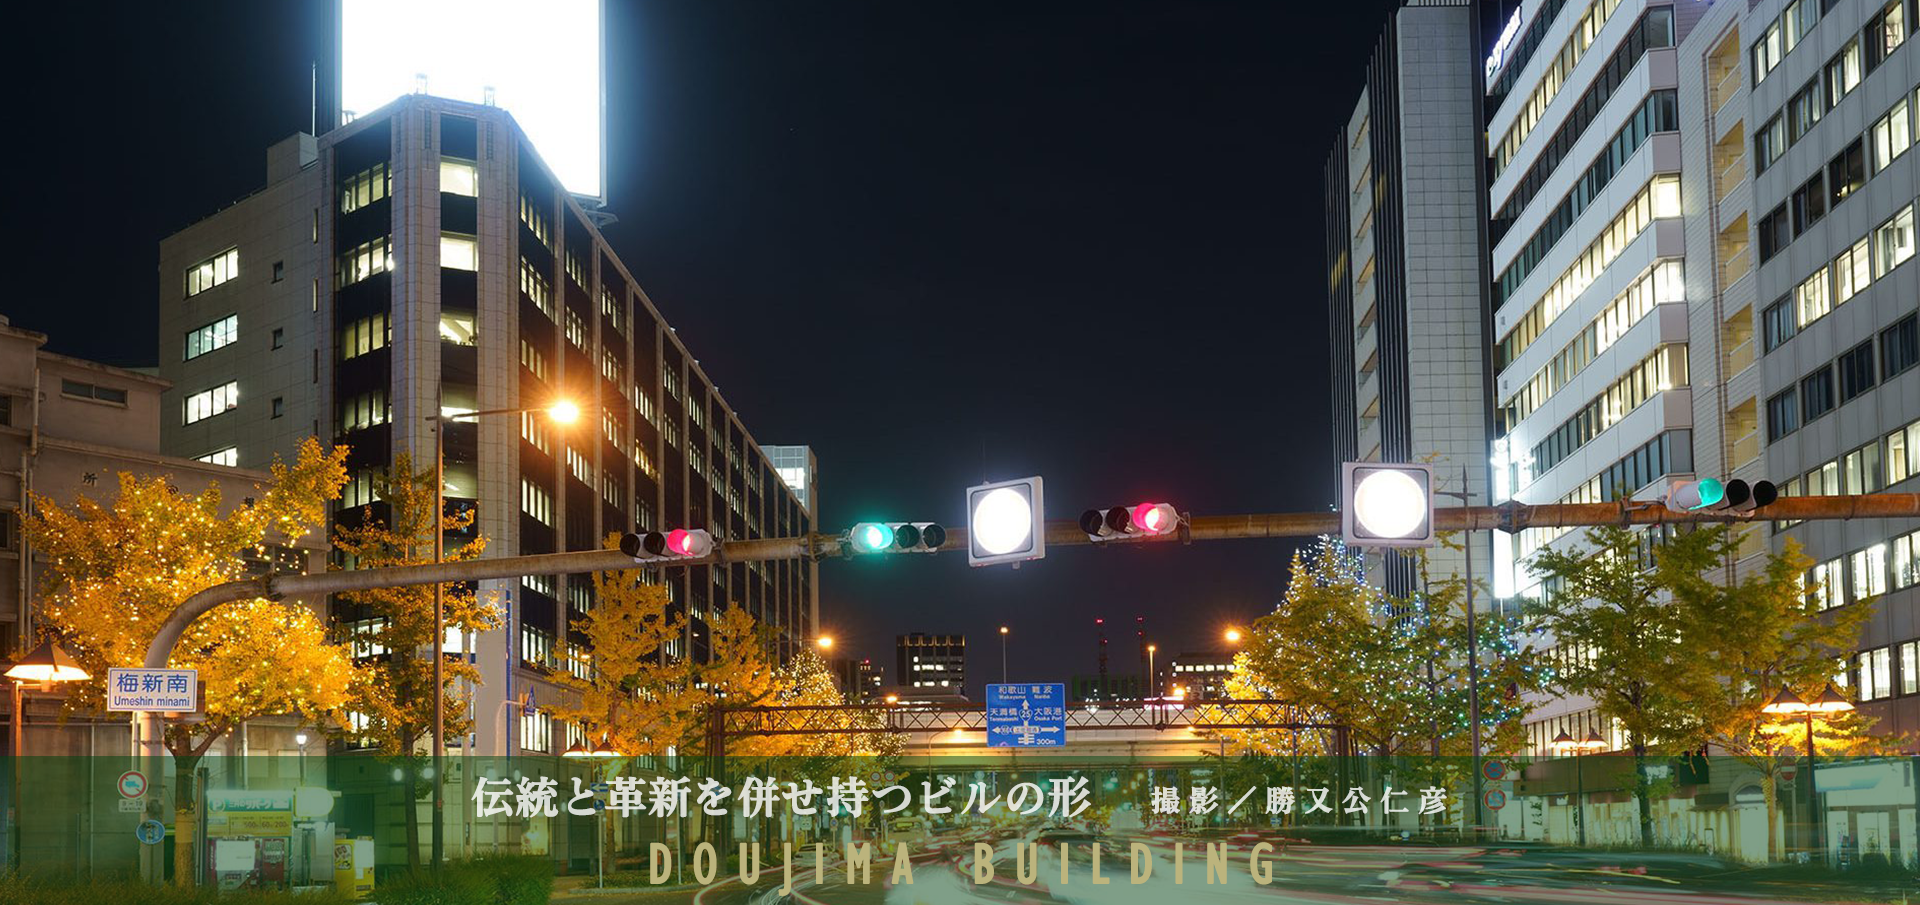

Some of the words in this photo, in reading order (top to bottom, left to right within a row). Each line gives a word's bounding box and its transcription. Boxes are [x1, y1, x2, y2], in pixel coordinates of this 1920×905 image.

[116, 673, 188, 693] 梅新南
[999, 686, 1026, 694] 和歌山
[114, 696, 153, 706] Umeshin
[156, 696, 190, 707] minami
[1021, 710, 1031, 718] 25
[1034, 708, 1062, 716] 大阪港
